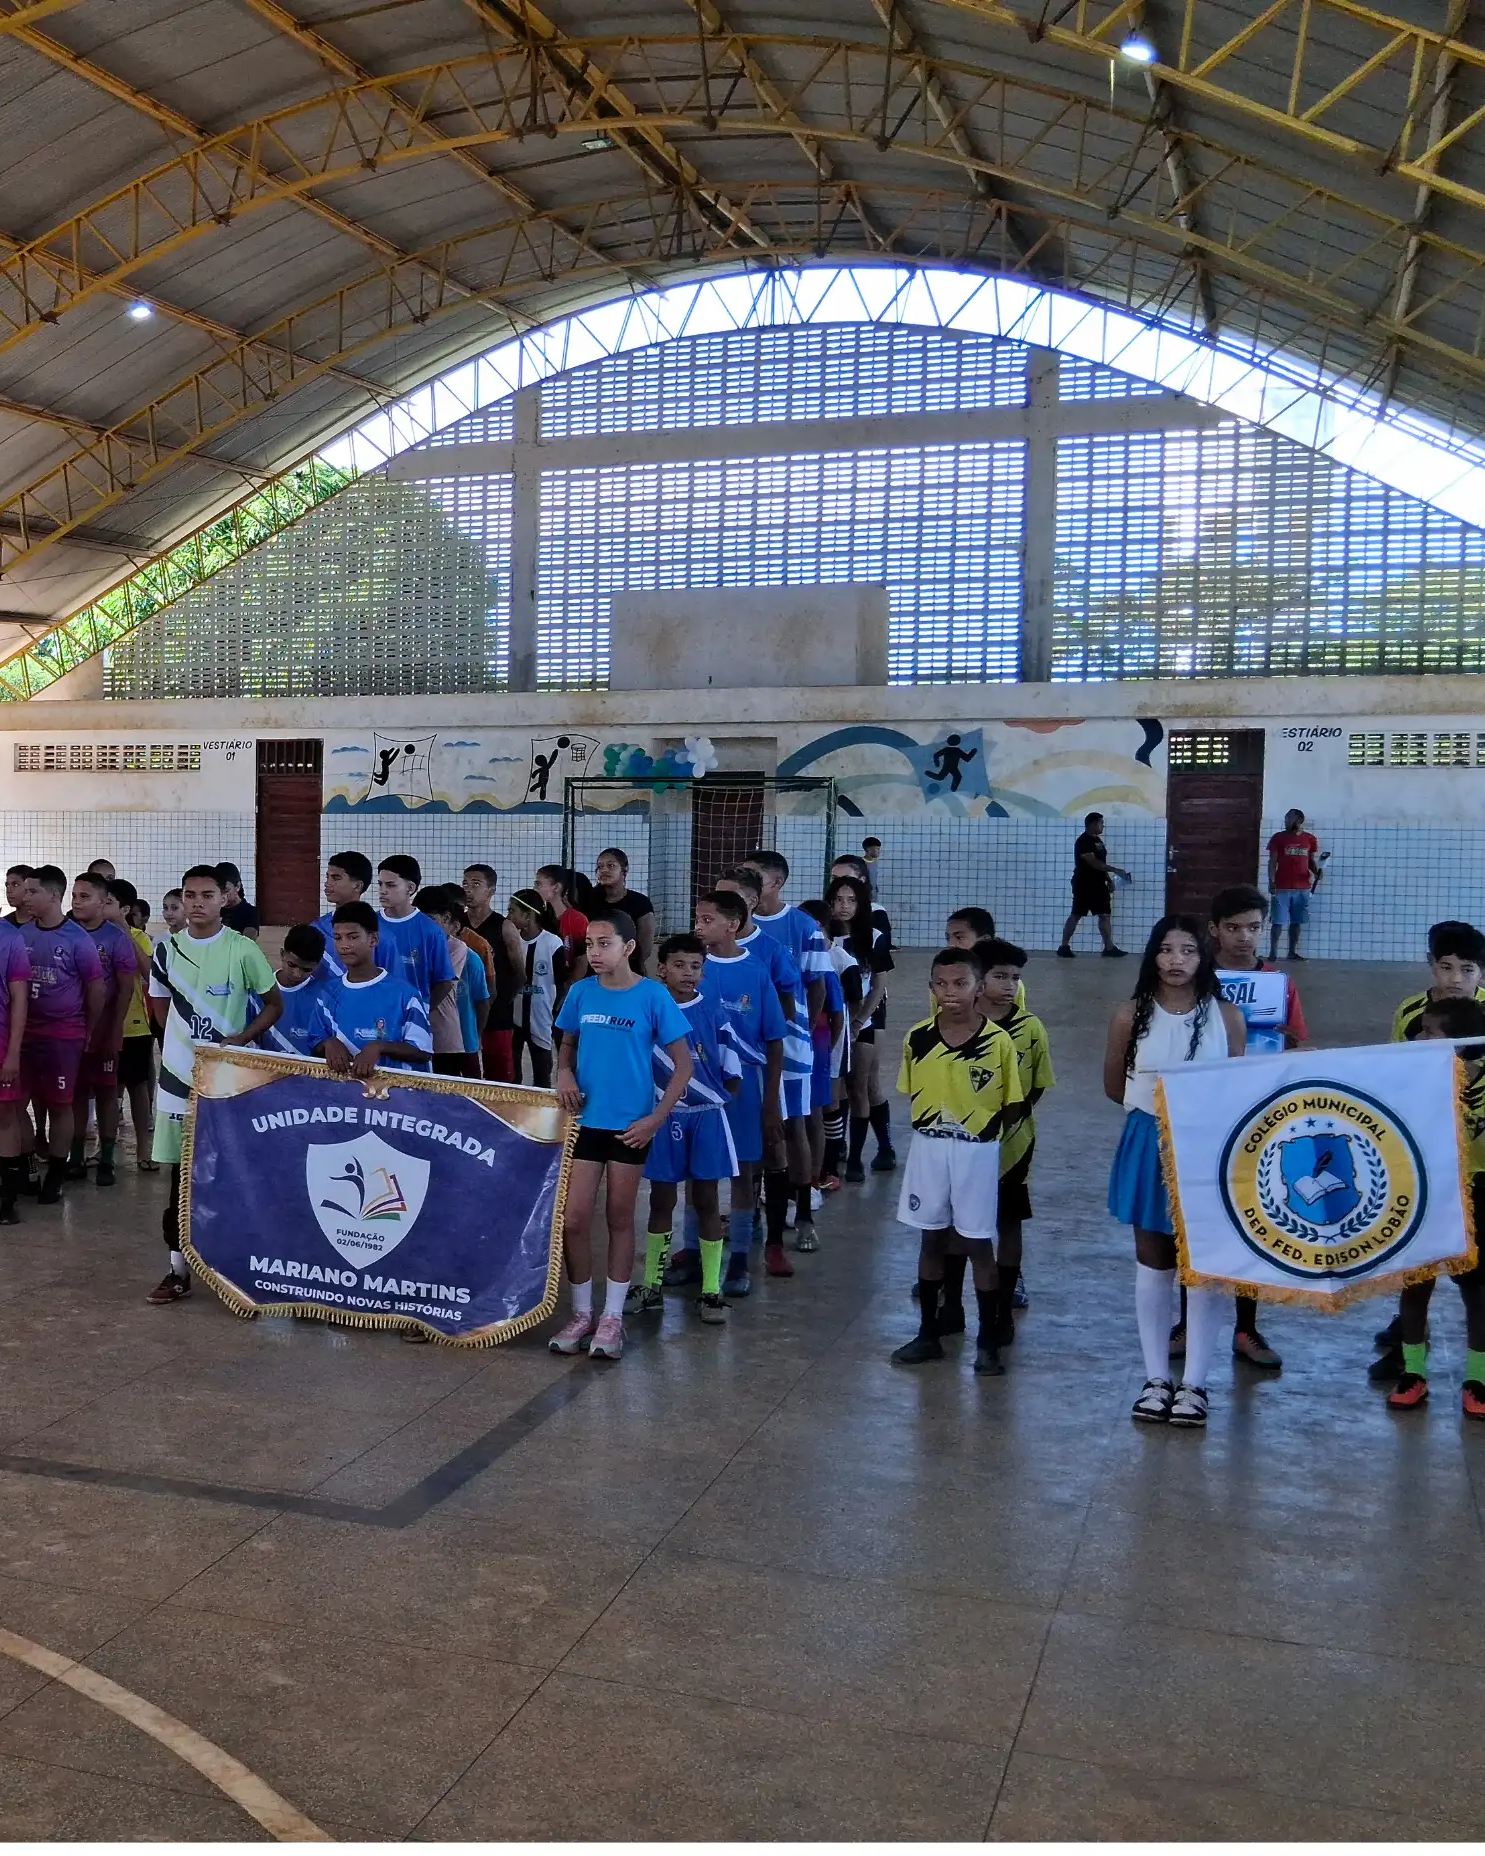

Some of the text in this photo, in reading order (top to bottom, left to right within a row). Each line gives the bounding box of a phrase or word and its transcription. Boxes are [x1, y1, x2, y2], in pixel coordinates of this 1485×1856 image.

[1272, 724, 1343, 738] ESTIÁRIO
[203, 738, 253, 750] VESTIÁRIO
[1297, 741, 1314, 752] 02
[225, 751, 236, 761] 01
[31, 983, 41, 999] 5
[190, 1014, 213, 1040] 12
[58, 1076, 66, 1089] 5
[671, 1121, 683, 1141] 5
[1244, 1097, 1388, 1154] COLÉGIO MUNICIPAL
[251, 1106, 497, 1168] UNIDADE INTEGRADA
[335, 1228, 386, 1243] FUNDAÇÃO
[1243, 1194, 1411, 1265] DEP. FED. EDISON LOBÃO
[335, 1237, 384, 1252] 02/06/1982
[250, 1254, 471, 1304] MARIANO MARTINS
[254, 1279, 463, 1322] CONSTRUINDO NOVAS HISTÓRIAS
